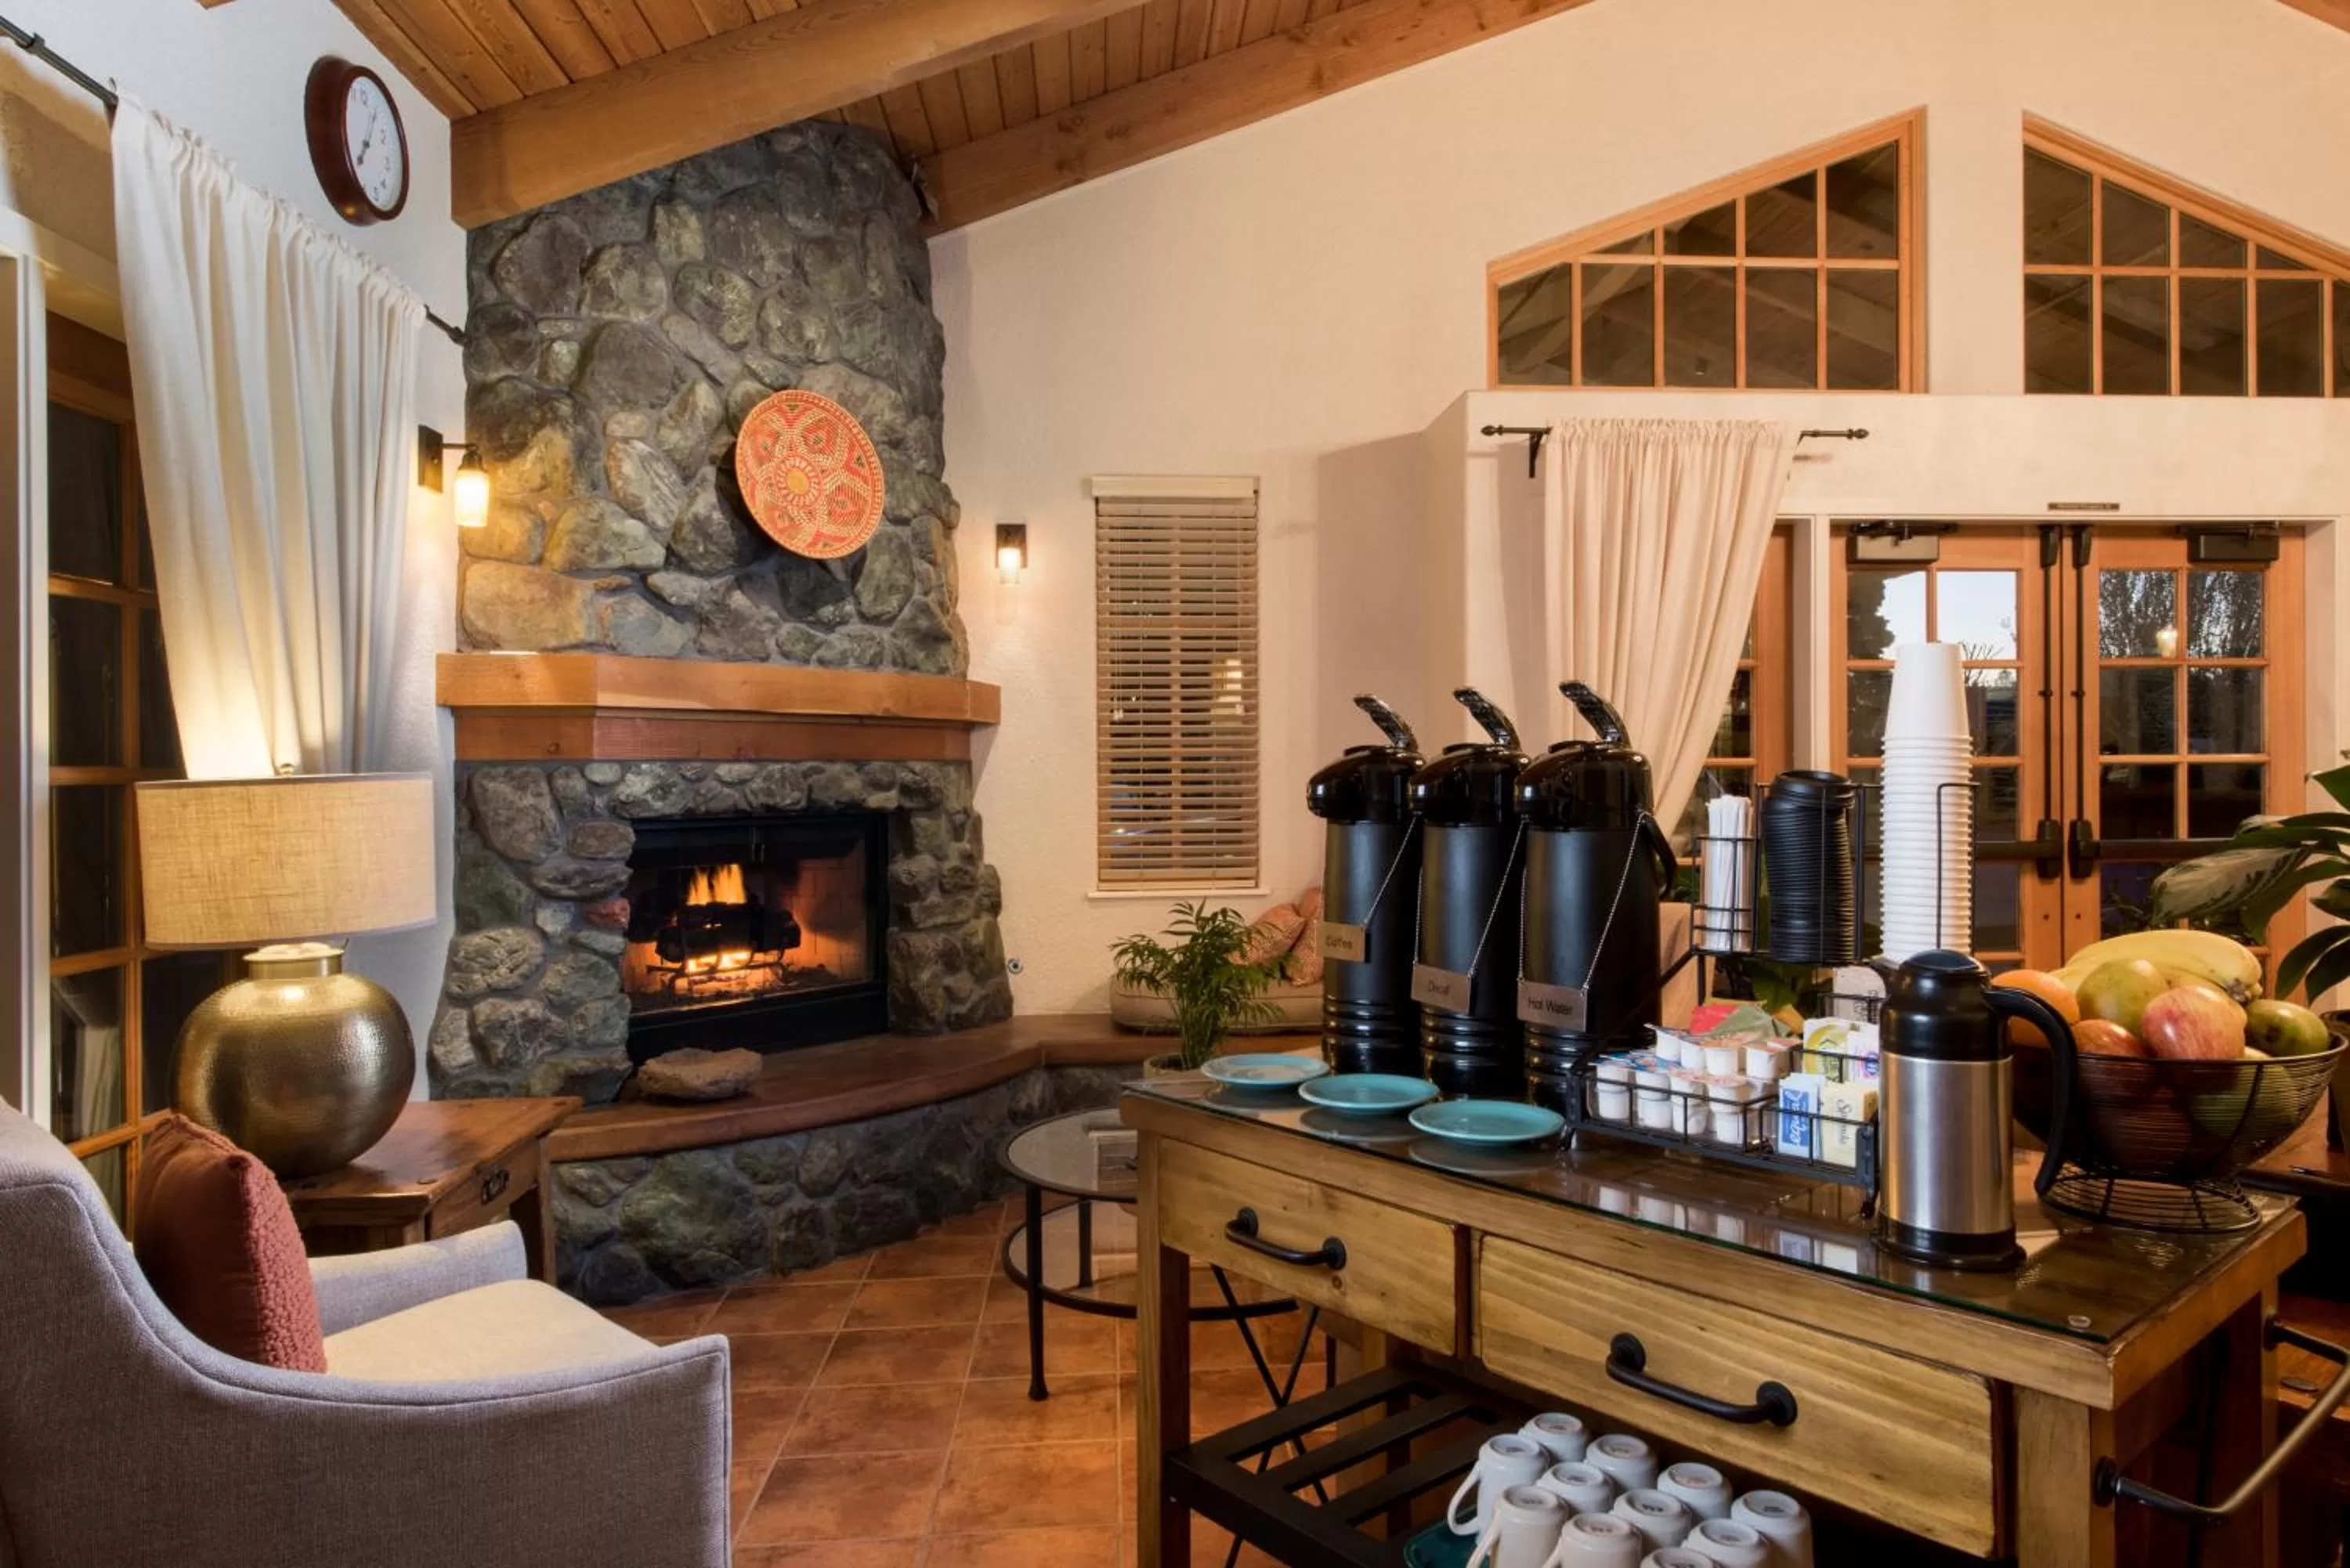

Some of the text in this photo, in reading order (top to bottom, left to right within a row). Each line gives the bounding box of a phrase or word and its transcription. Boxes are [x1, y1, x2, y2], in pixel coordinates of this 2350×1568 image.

[1325, 935, 1354, 950] Coffee
[1428, 980, 1451, 996] Decaf
[1528, 996, 1573, 1016] Hot Water
[1784, 1090, 1807, 1143] equal
